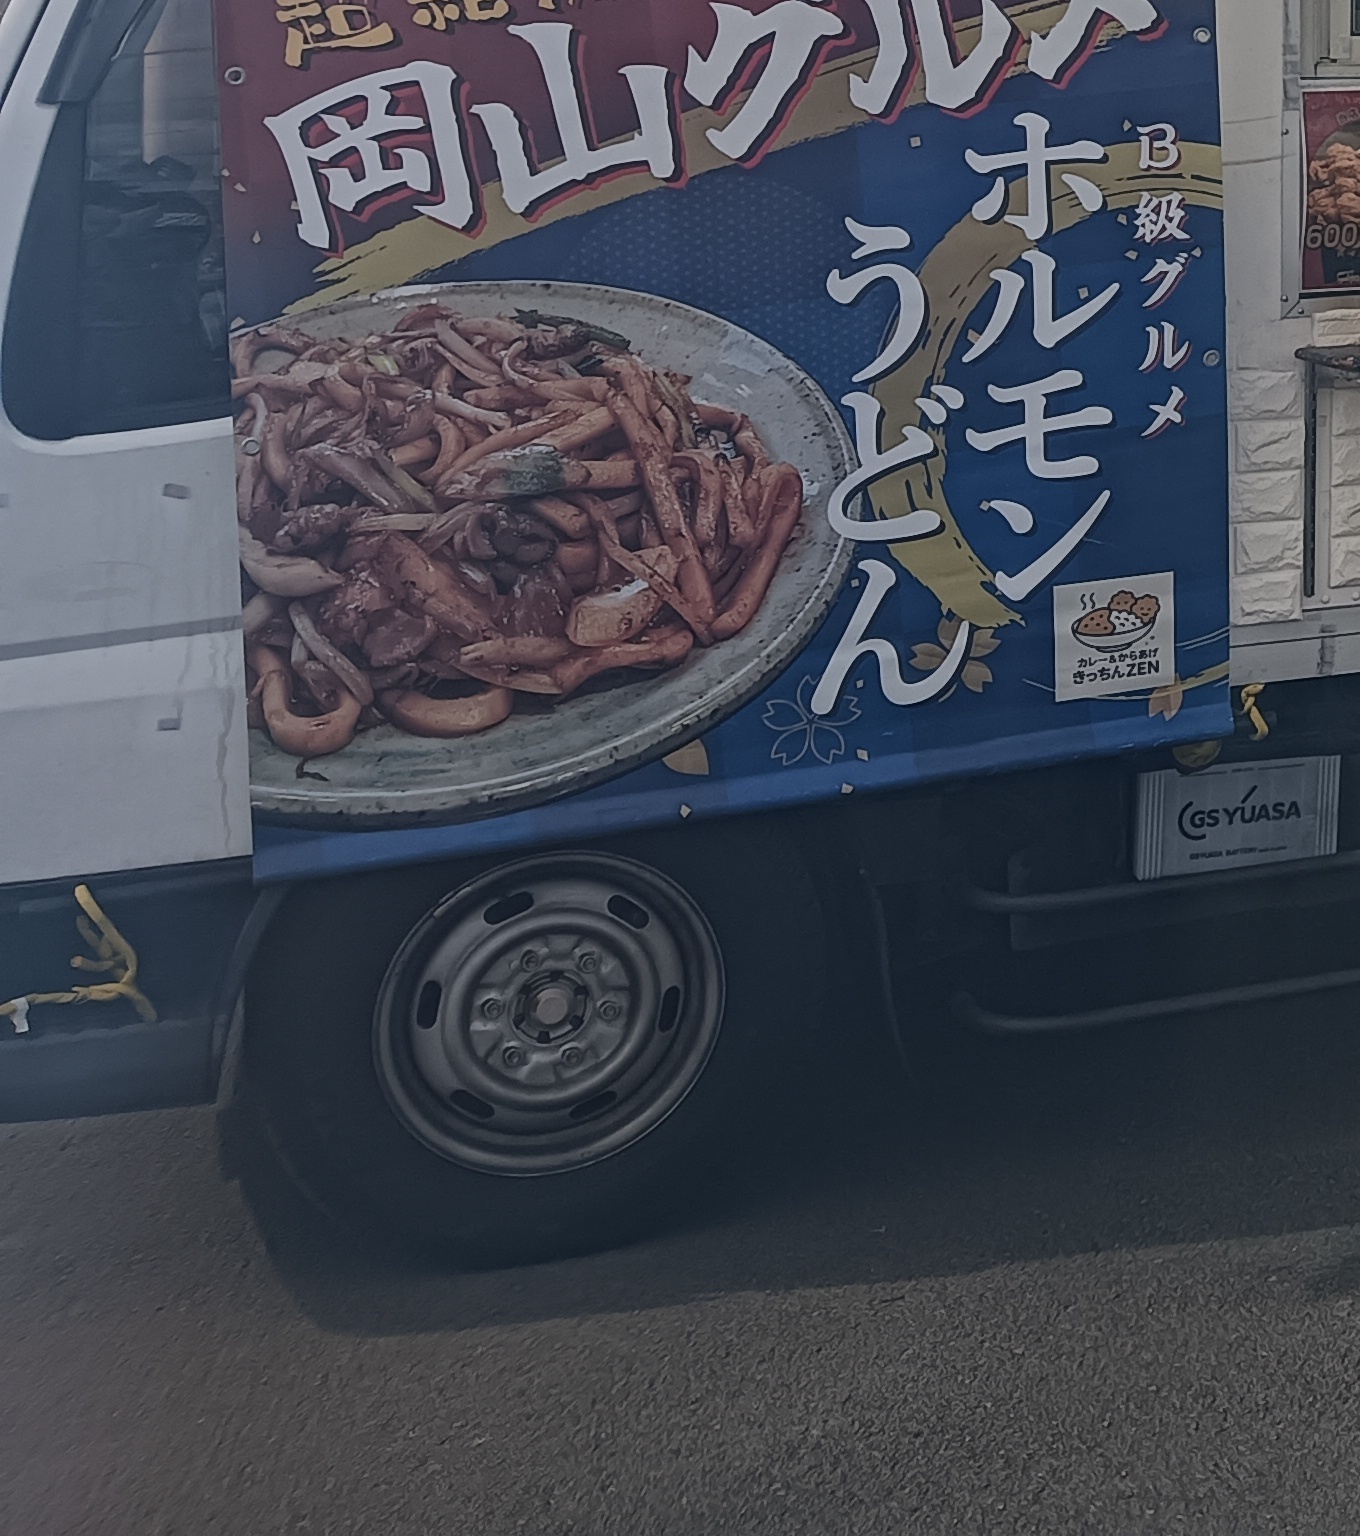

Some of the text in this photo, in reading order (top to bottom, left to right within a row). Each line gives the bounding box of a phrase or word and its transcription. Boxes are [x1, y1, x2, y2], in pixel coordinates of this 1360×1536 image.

[1306, 221, 1358, 249] 600
[1131, 122, 1193, 438] B級グルメ
[810, 111, 1120, 716] ホルモン うどん
[1072, 659, 1160, 685] きっちんZEN
[1189, 792, 1302, 829] GS YUASA
